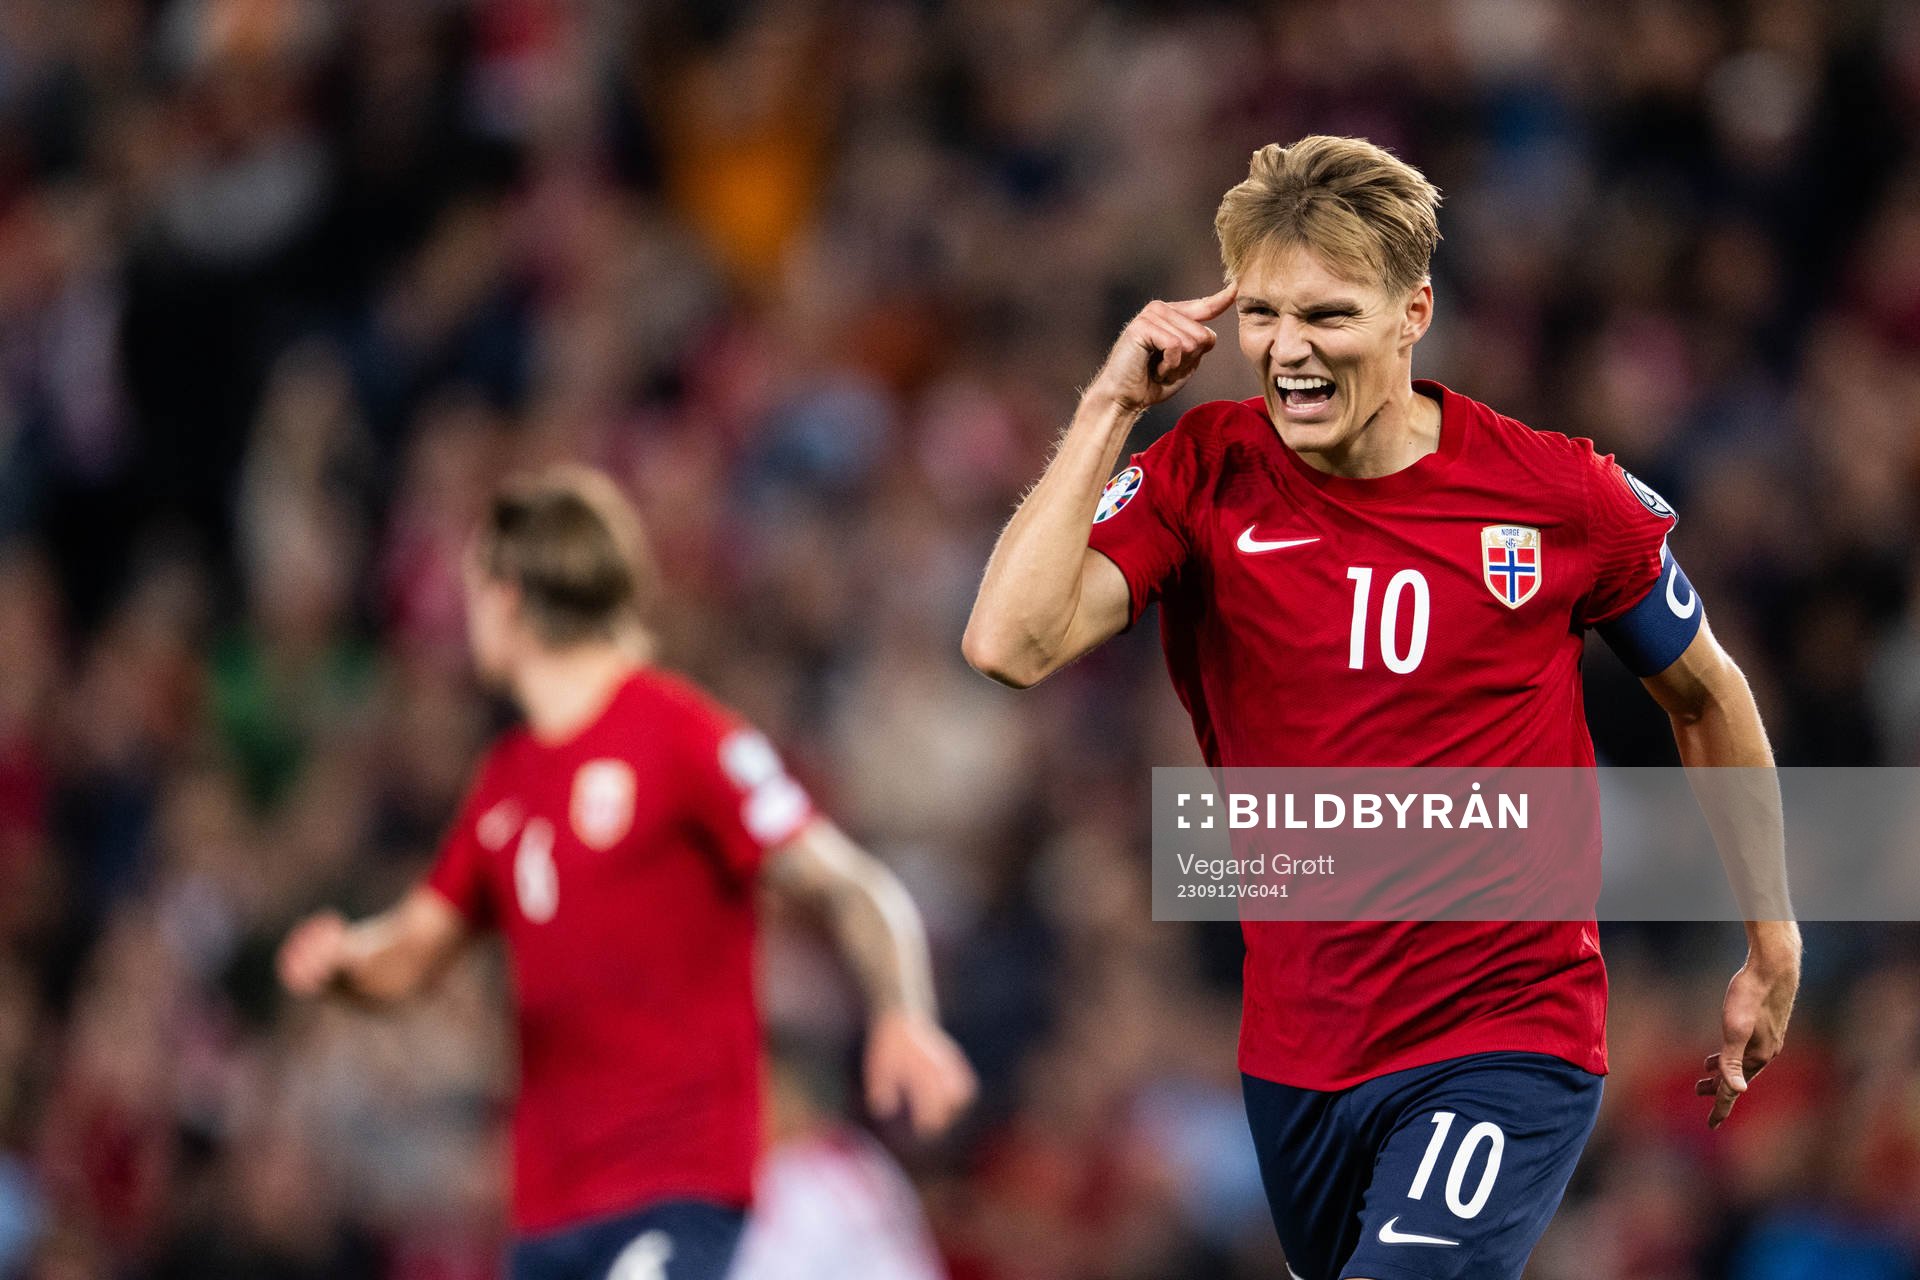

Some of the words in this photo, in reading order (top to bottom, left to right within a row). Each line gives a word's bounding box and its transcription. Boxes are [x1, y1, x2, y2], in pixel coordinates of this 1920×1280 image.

[1501, 528, 1520, 537] NORGE
[1346, 566, 1431, 675] 10
[1407, 1111, 1505, 1220] 10
